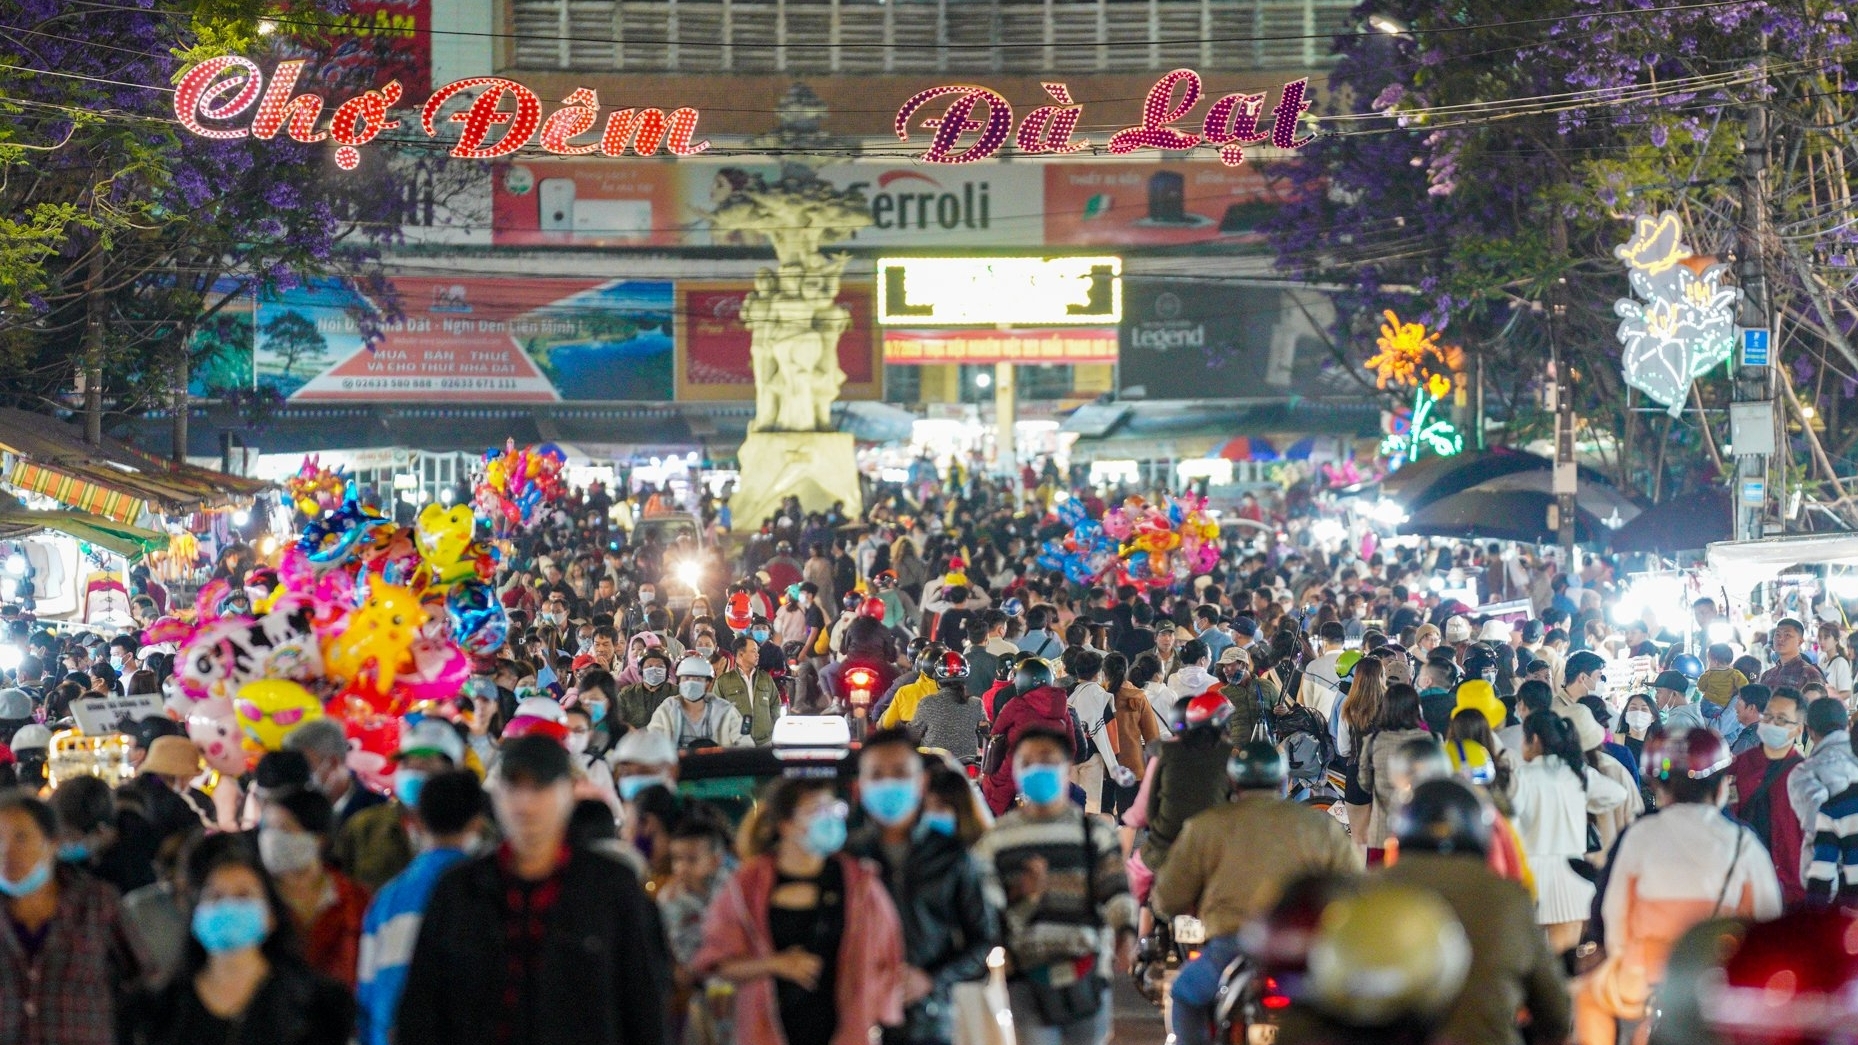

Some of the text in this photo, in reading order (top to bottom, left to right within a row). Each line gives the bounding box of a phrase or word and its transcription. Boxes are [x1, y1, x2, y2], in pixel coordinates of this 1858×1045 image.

[174, 55, 403, 171] Chợ
[421, 76, 711, 159] Đêm
[895, 83, 1090, 164] Đà
[1108, 68, 1319, 167] Lạt
[1131, 324, 1205, 352] Legend
[374, 350, 407, 361] MUA
